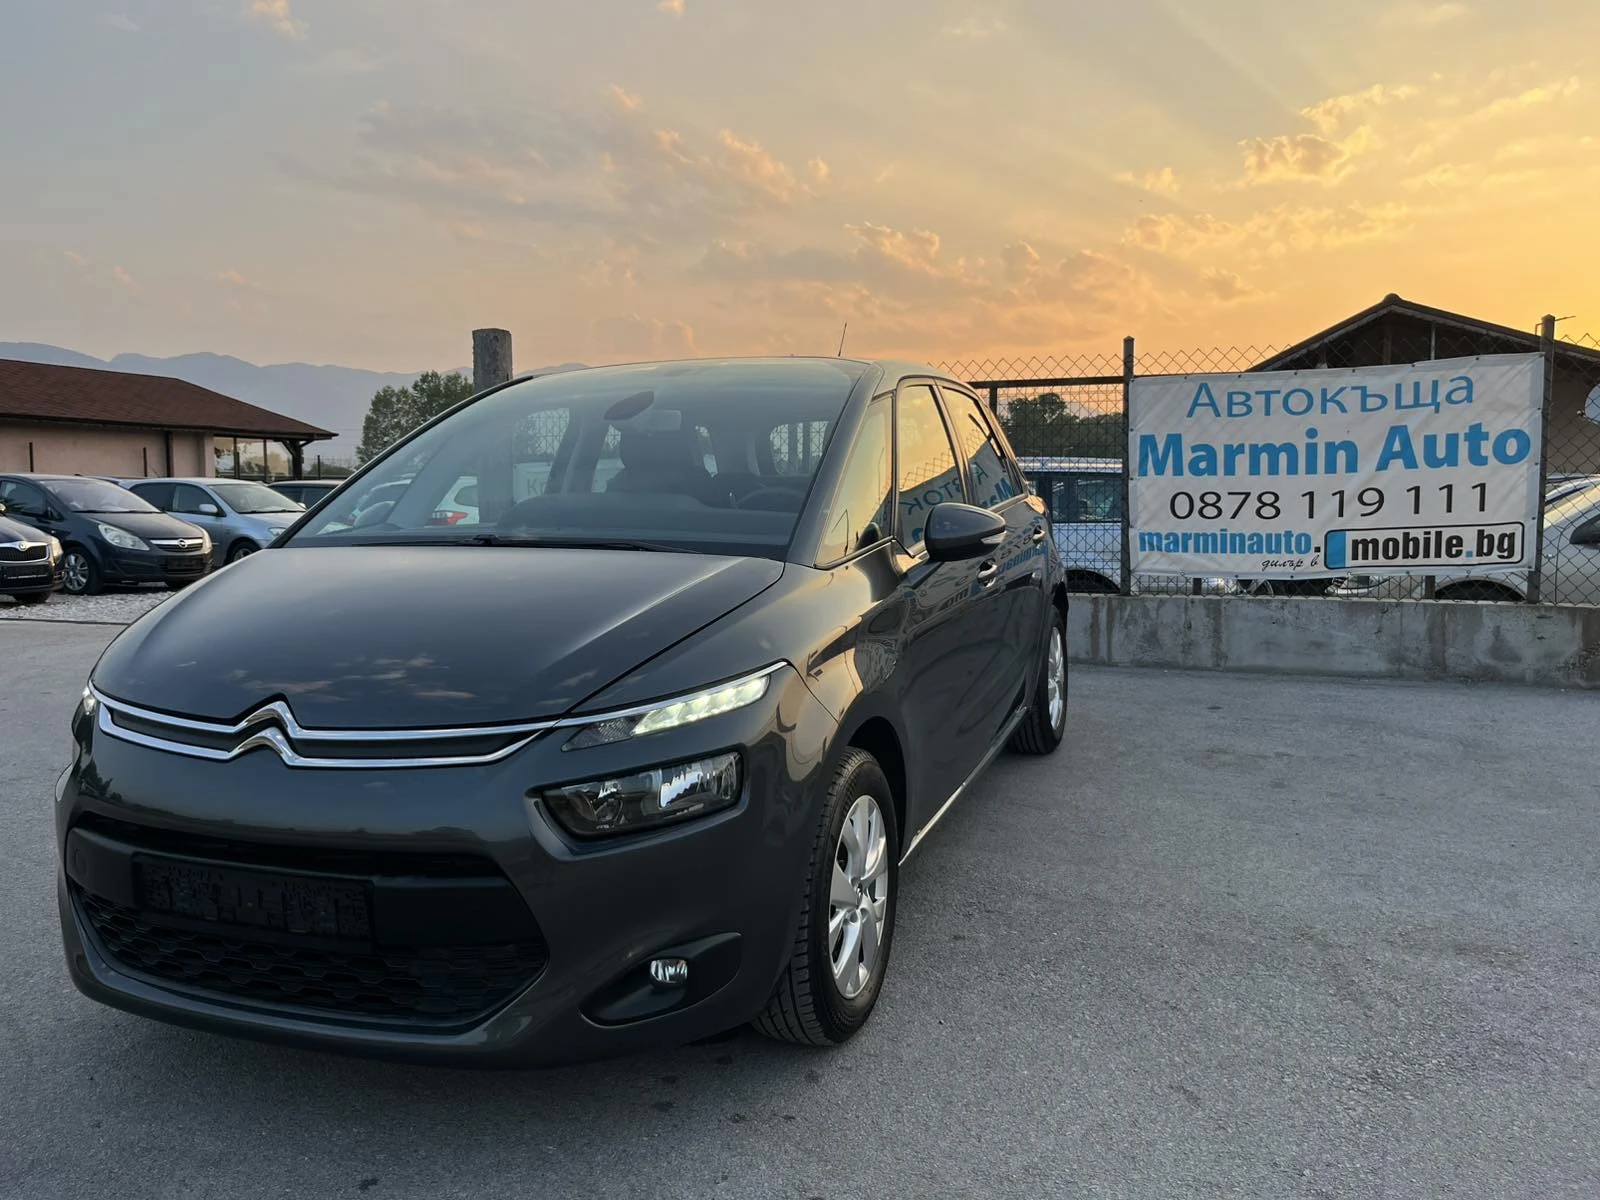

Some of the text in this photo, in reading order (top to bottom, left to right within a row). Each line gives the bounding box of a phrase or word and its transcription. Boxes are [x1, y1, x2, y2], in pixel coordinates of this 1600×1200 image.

[1187, 375, 1474, 418] Автокъща
[1138, 422, 1531, 477] Marmin Auto
[1169, 483, 1488, 520] 0878 119 111
[1351, 529, 1516, 561] mobile.bg
